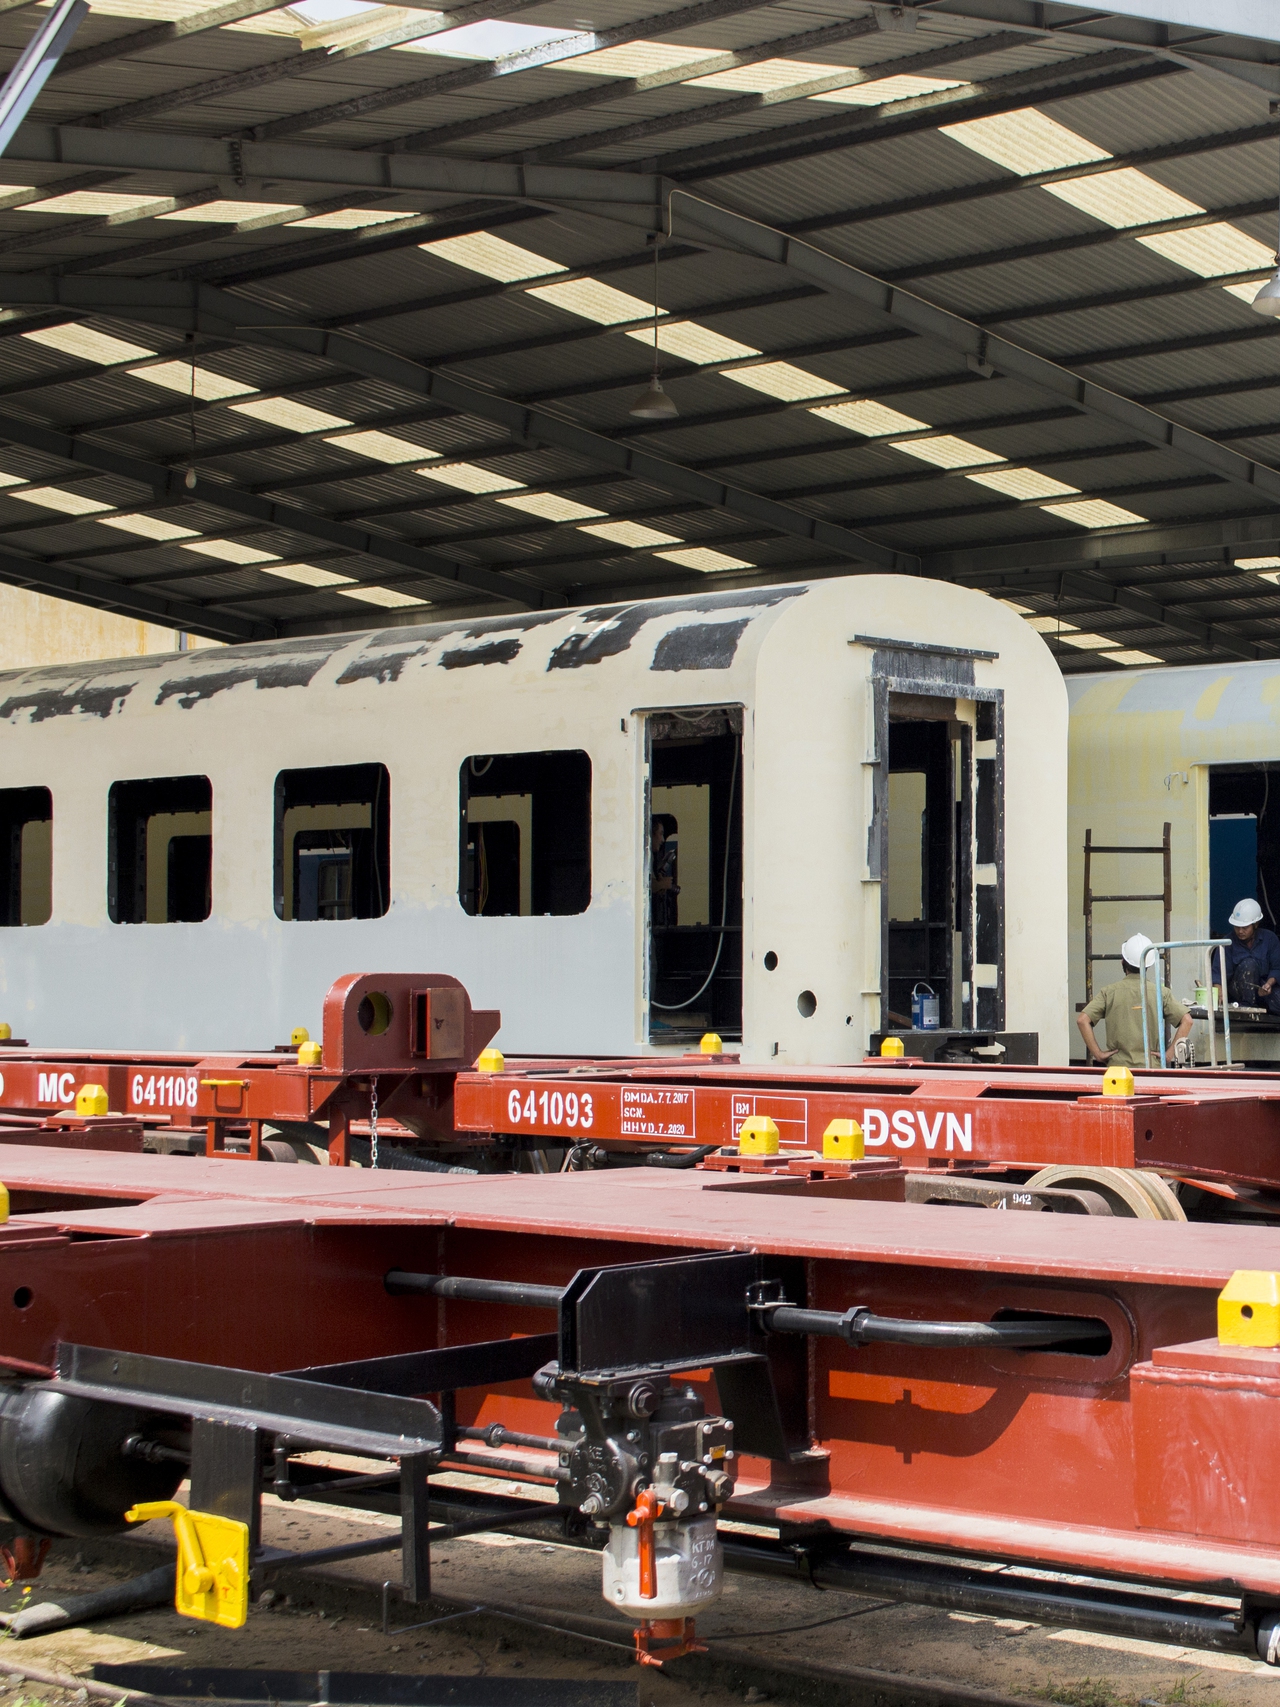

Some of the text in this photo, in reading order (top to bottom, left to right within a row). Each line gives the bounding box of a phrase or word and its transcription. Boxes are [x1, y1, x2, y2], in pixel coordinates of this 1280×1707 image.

[38, 1072, 76, 1103] MC
[132, 1074, 198, 1107] 641108
[507, 1089, 594, 1129] 641093
[735, 1102, 750, 1114] BM
[860, 1108, 972, 1152] ĐSVN
[1012, 1193, 1032, 1205] 942
